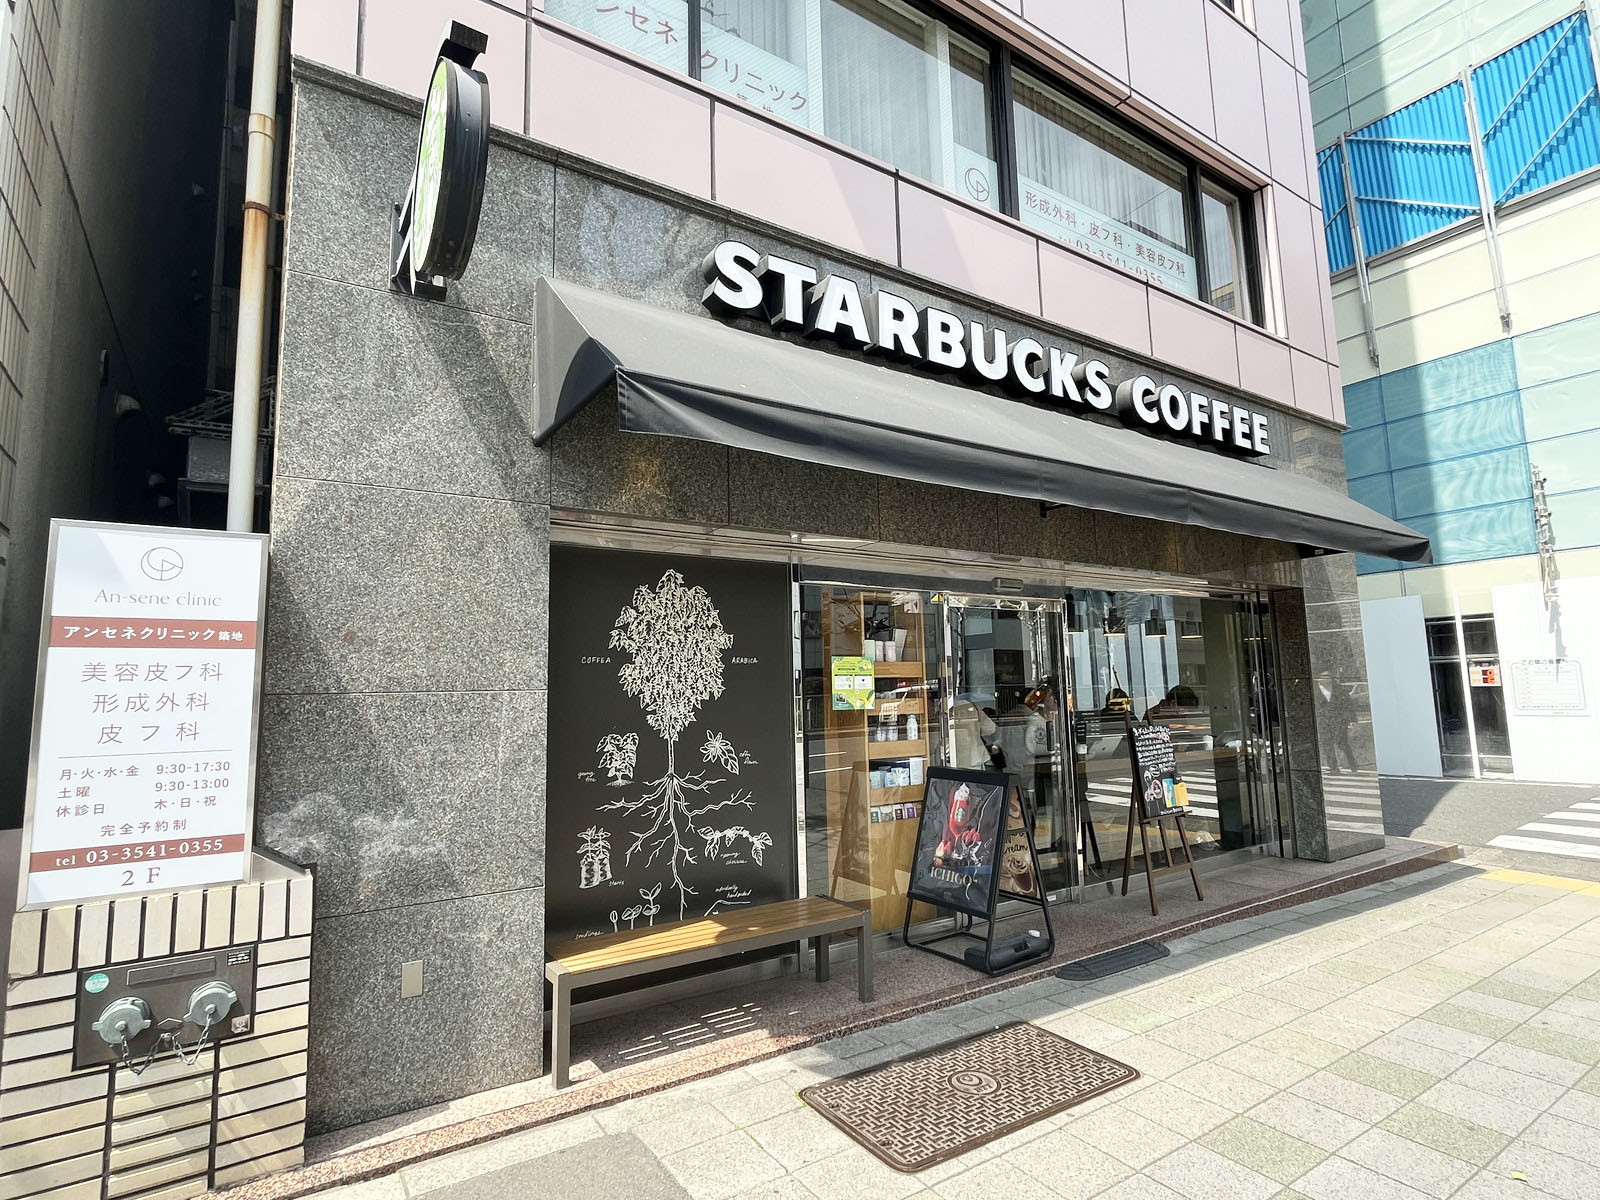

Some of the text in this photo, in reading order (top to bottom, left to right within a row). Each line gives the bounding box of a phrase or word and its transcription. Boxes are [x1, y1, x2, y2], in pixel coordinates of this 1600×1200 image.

[710, 240, 1271, 456] STARBUCKS COFFEE
[94, 588, 223, 607] An-sene clinic
[81, 661, 223, 683] 美容皮フ科
[92, 692, 209, 713] 形成外科
[97, 721, 200, 745] 皮フ科
[156, 761, 231, 775] 9:30-17:30
[57, 778, 230, 799] 土曜 9:30-13:00
[56, 803, 105, 818] 休診日
[100, 818, 187, 837] 完全予約制
[55, 838, 224, 867] tel 03-3541-0355
